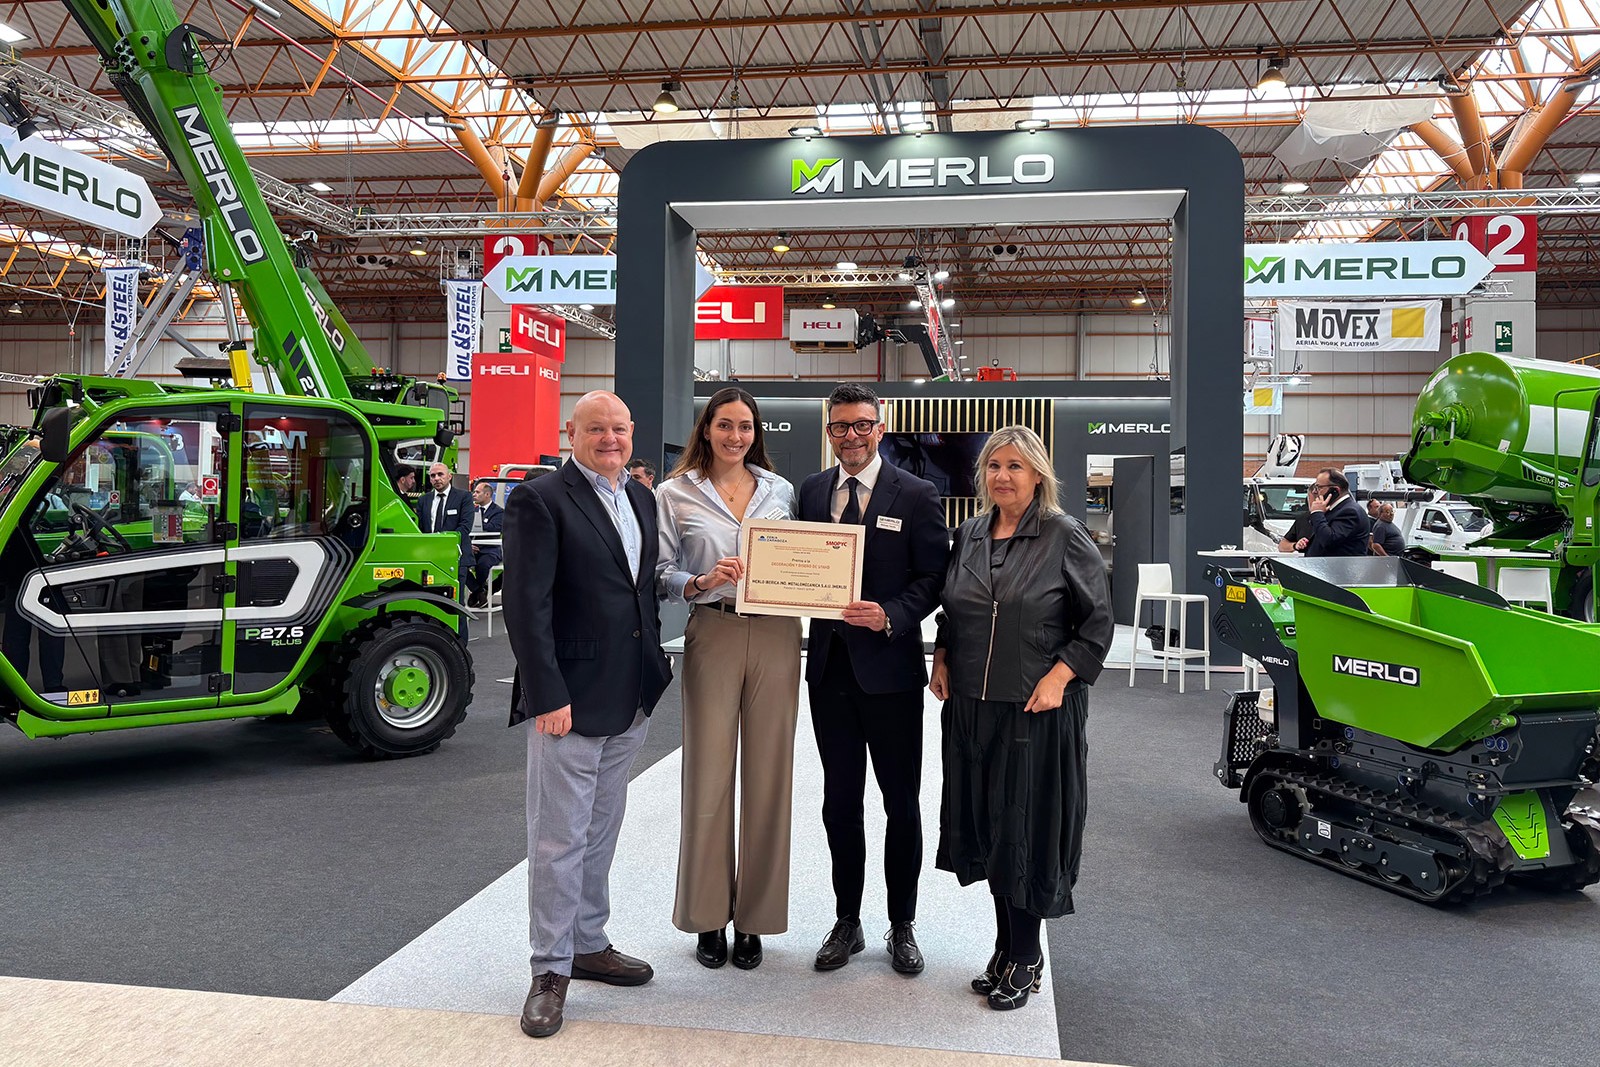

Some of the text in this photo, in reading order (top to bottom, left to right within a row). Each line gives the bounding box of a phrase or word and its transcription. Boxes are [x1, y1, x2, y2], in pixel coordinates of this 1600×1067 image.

[0, 143, 142, 219] MERLO
[175, 106, 264, 262] MERLO
[853, 154, 1055, 189] MERLO
[1486, 215, 1526, 265] 2
[1294, 255, 1467, 281] MERLO
[518, 313, 560, 348] HELI
[802, 321, 842, 330] HELI
[479, 365, 530, 376] HELI
[539, 366, 559, 382] HELI
[1261, 655, 1290, 667] MERLO
[1334, 656, 1418, 685] MERLO
